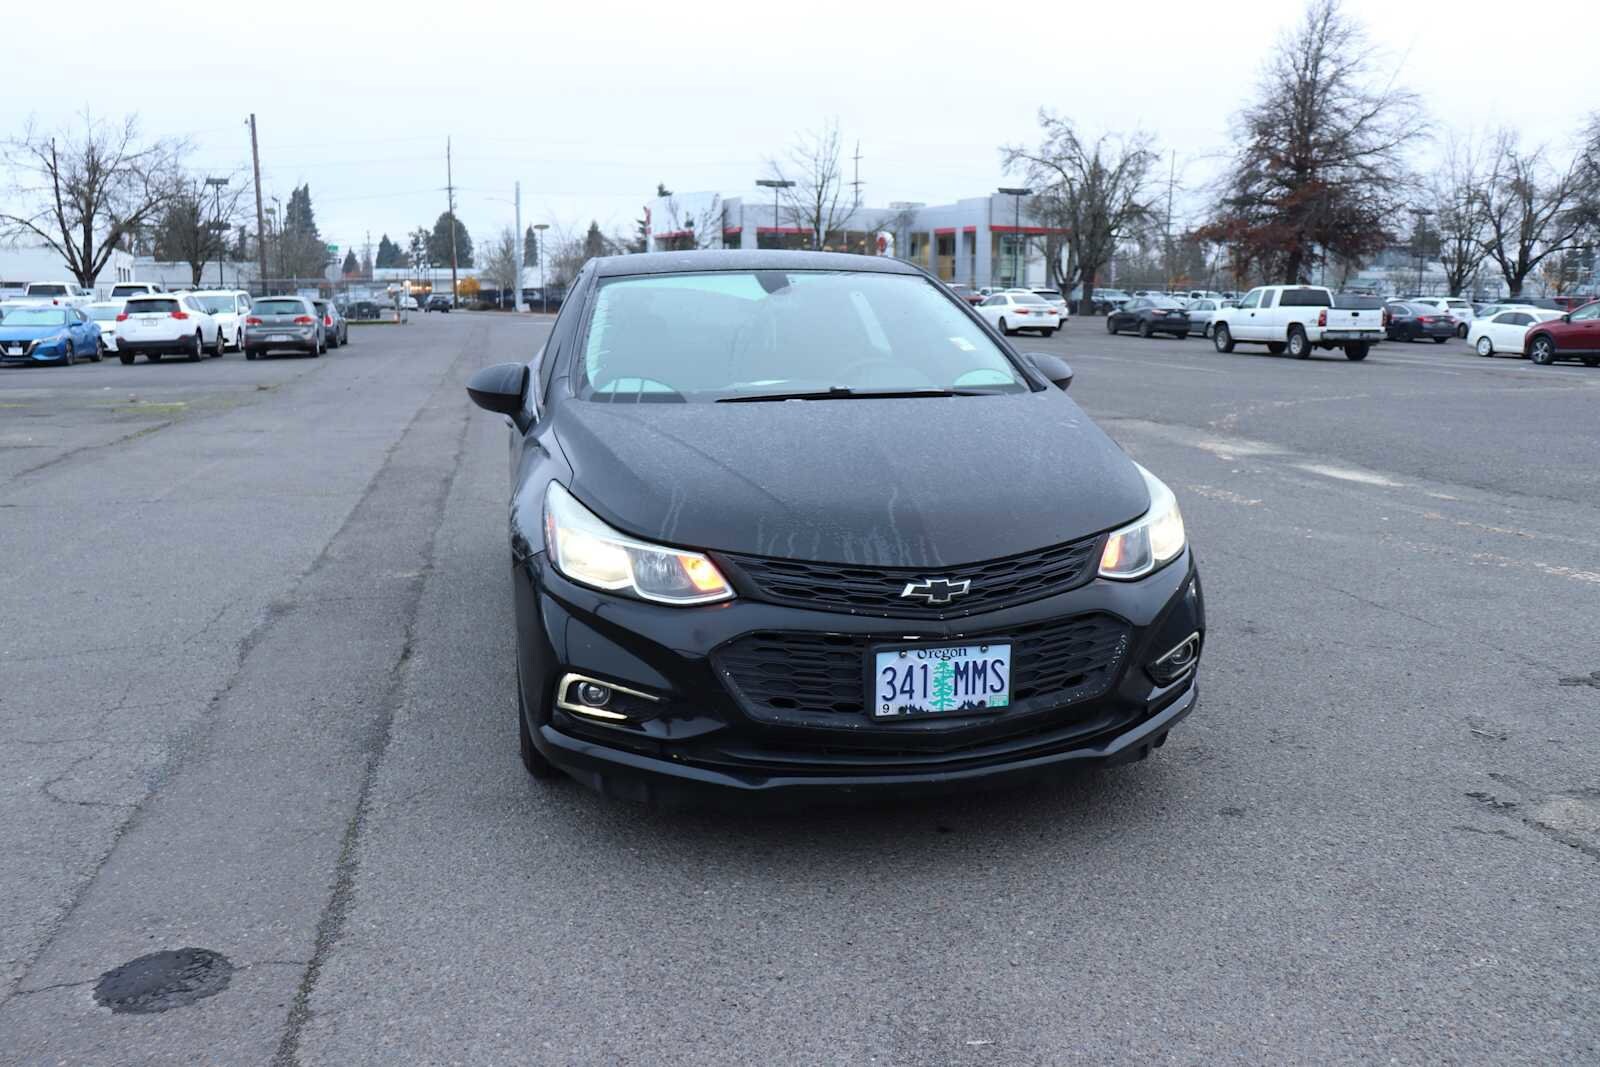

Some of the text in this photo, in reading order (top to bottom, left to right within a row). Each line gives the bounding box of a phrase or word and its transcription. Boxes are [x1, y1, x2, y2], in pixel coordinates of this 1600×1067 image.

[917, 648, 967, 661] Oregon
[882, 659, 1005, 702] 341 MMS
